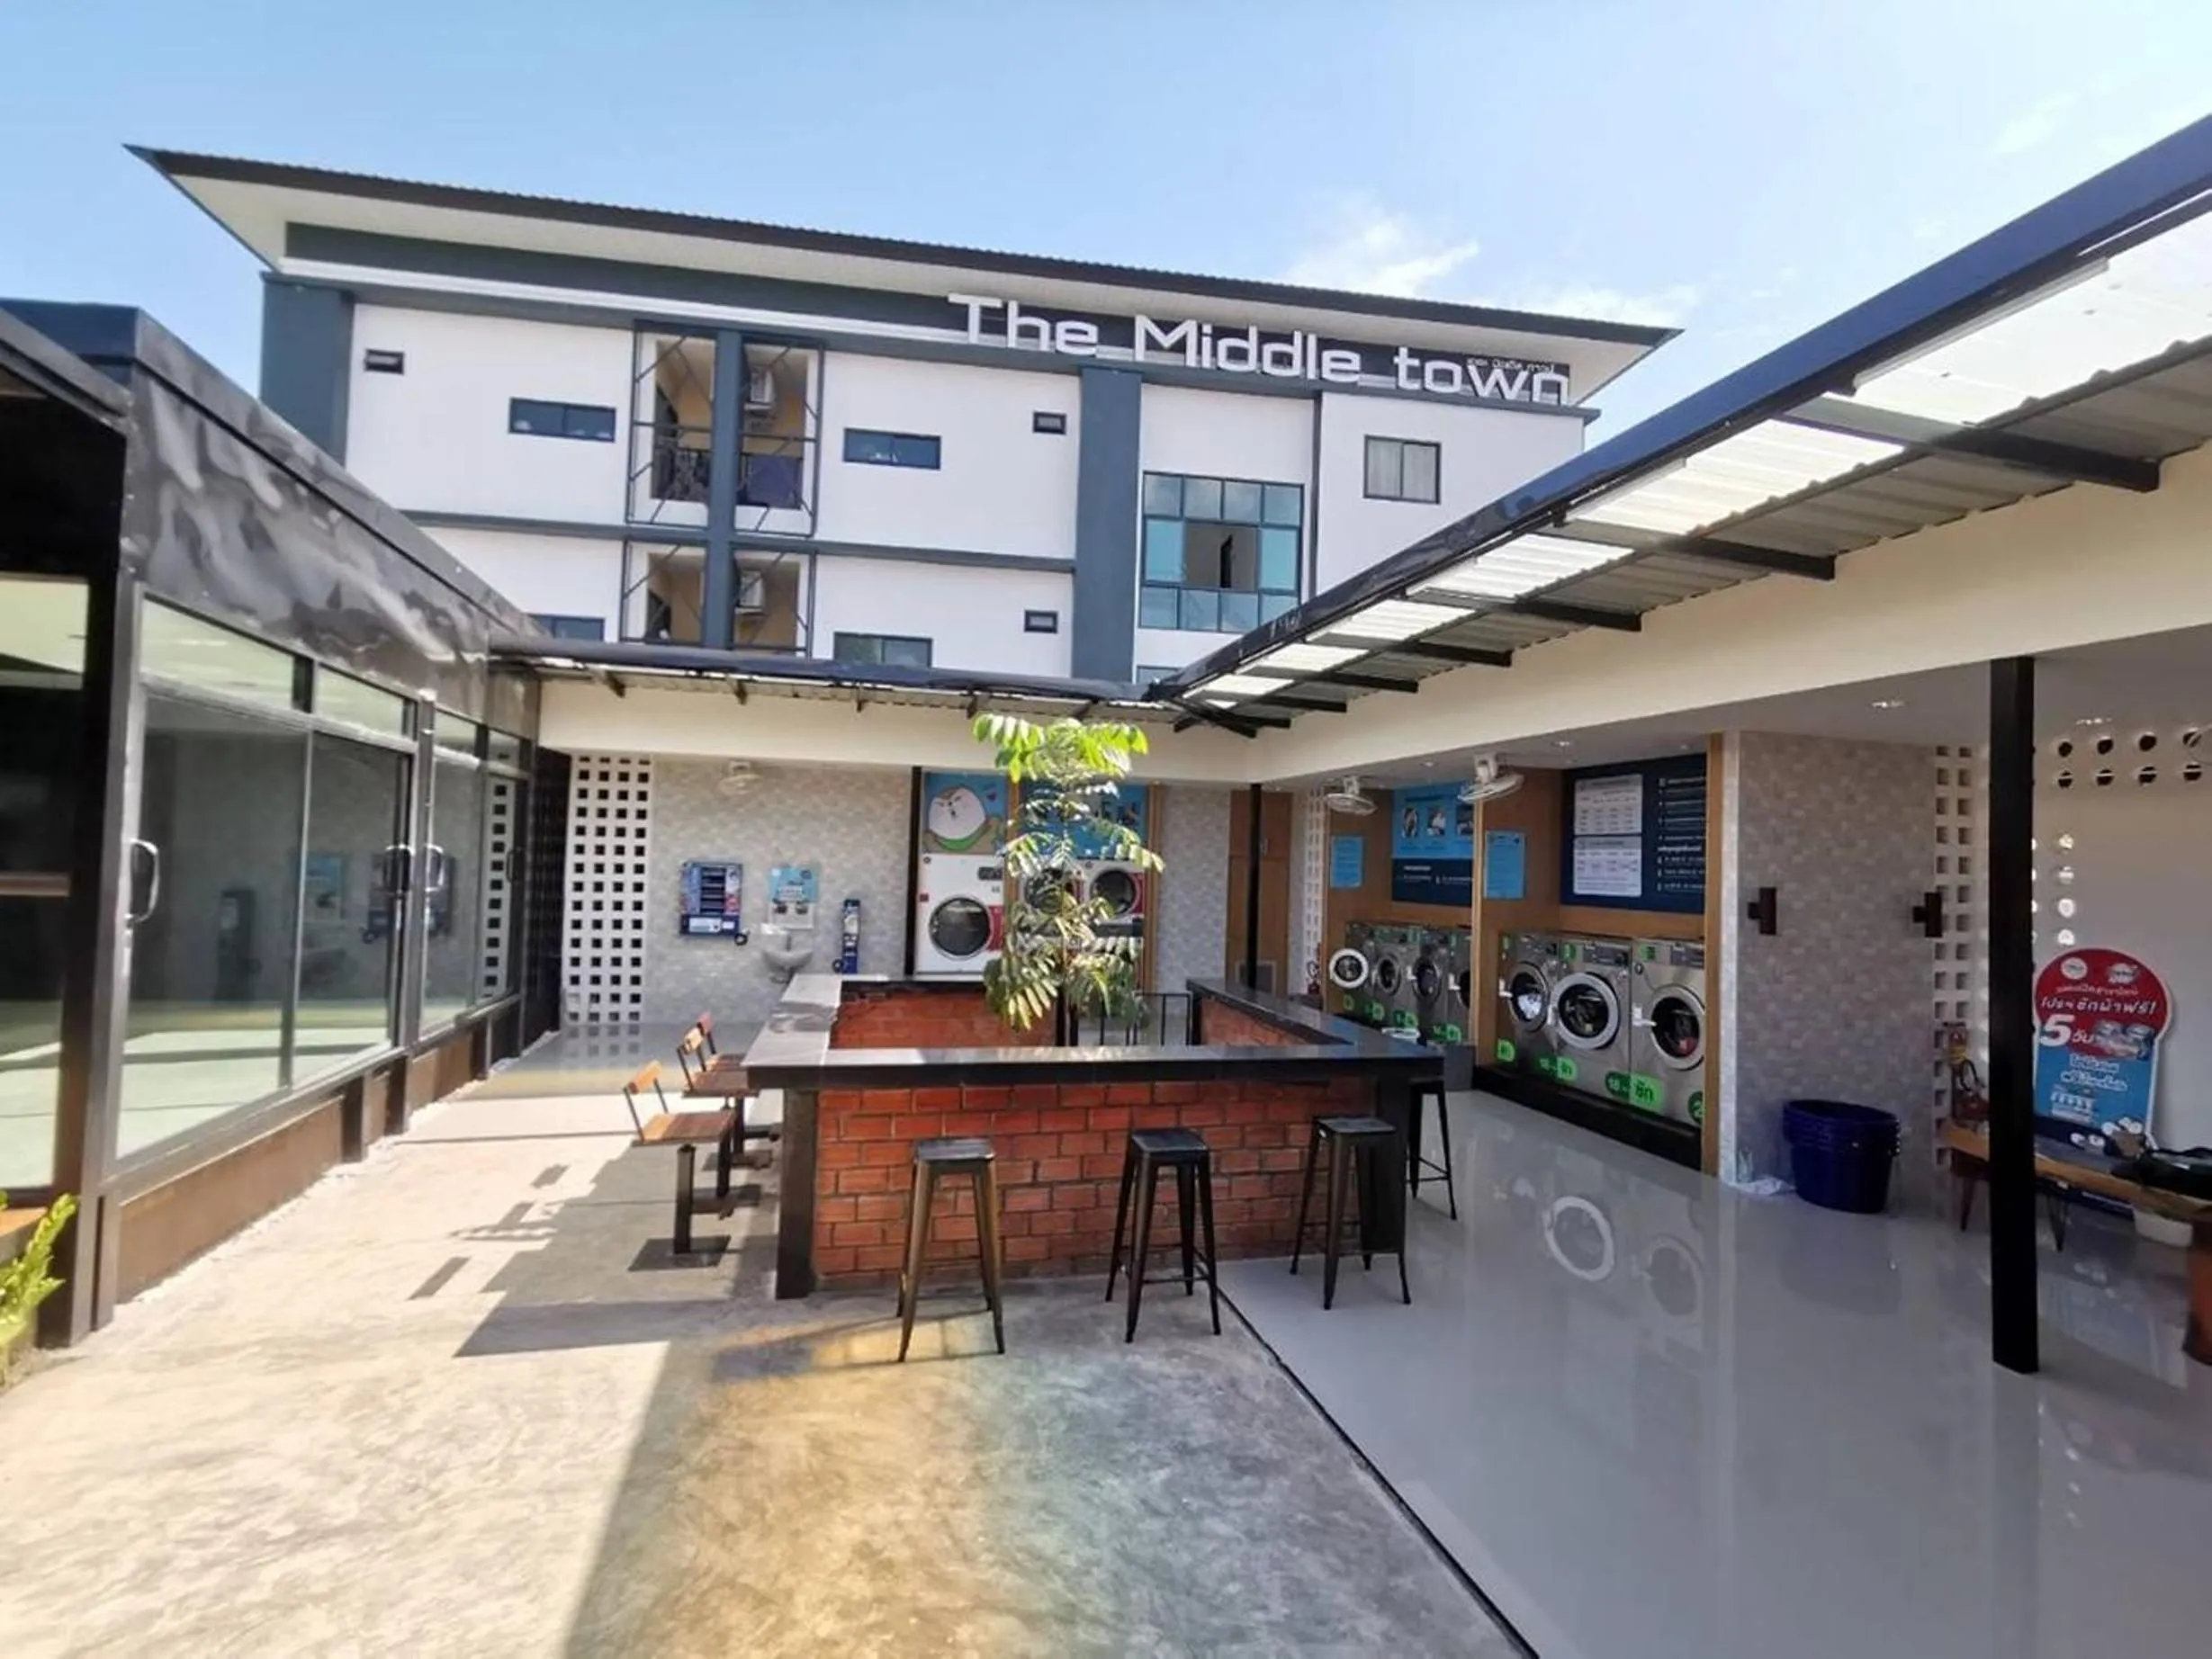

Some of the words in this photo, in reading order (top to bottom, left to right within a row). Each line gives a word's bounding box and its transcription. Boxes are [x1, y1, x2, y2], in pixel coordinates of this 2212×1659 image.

[948, 293, 1099, 355] The
[1135, 314, 1362, 382] Middle
[1393, 346, 1569, 405] town
[2039, 1013, 2075, 1047] 5
